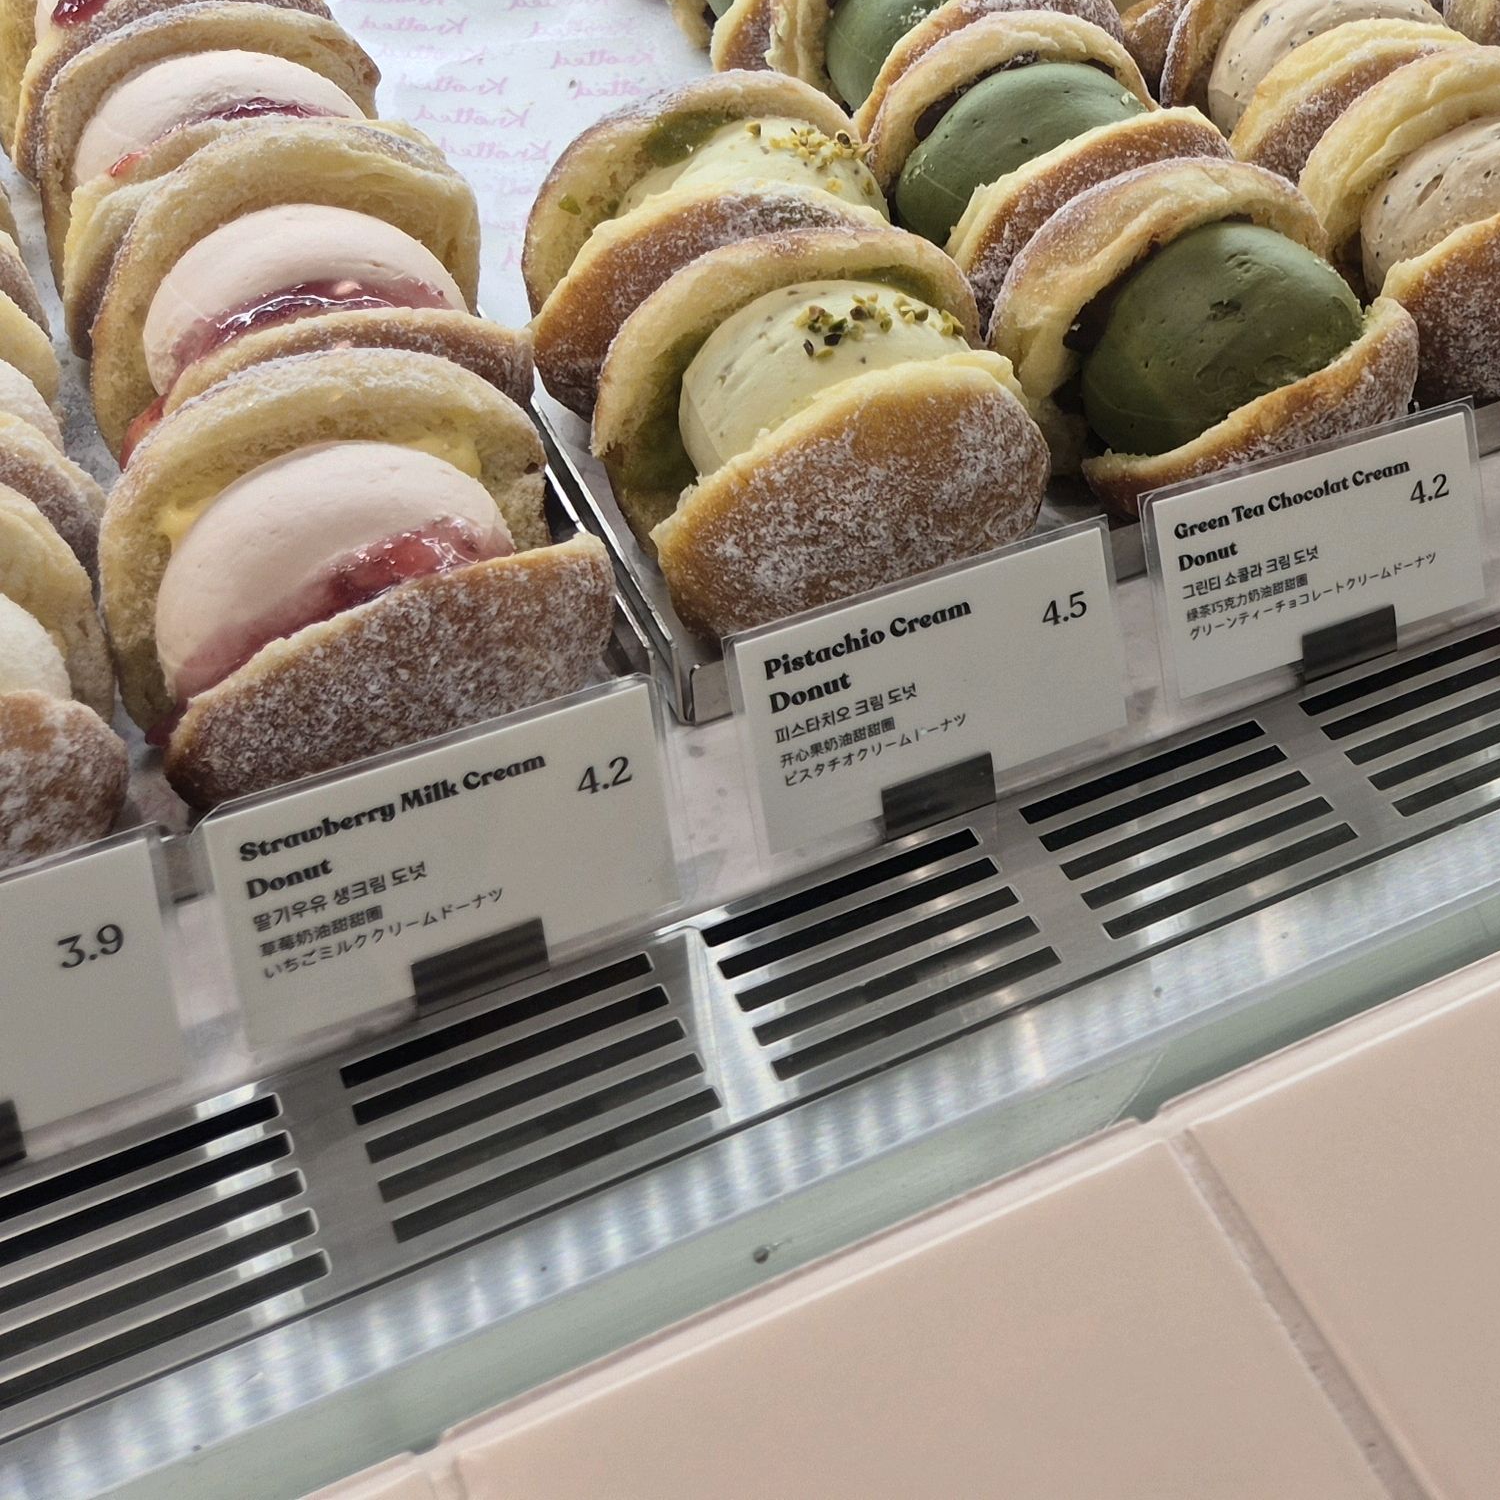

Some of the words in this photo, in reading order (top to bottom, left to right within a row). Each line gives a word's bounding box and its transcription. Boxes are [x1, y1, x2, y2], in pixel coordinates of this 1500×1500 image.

[1173, 514, 1231, 540] Green
[1231, 503, 1266, 523] Tea
[1267, 476, 1350, 512] Chocolat
[1351, 461, 1411, 487] Cream
[1409, 473, 1450, 505] 4.2
[1177, 541, 1239, 572] Donut
[1182, 574, 1222, 600] 그린티
[1224, 561, 1263, 587] 쇼콜라
[1265, 553, 1291, 574] 크림
[1293, 544, 1320, 566] 도넛
[1041, 590, 1088, 626] 4.5
[1189, 551, 1437, 641] グリーンティーチョコレートクリームドーナツ
[763, 627, 886, 681] Pistachio
[889, 601, 972, 638] Cream
[768, 672, 852, 715] Donut
[774, 706, 852, 744] 피스타치오
[854, 693, 885, 717] 크림
[887, 682, 918, 706] 도넛
[779, 715, 896, 769] 开心果奶油甜甜圈
[576, 755, 633, 795] 4.2
[238, 802, 396, 862] Strawberry
[399, 779, 460, 813] Milk
[461, 755, 547, 791] Cream
[245, 858, 334, 900] Donut
[252, 894, 329, 933] 딸기우유
[332, 873, 387, 906] 생크림
[390, 860, 428, 887] 도넛
[57, 923, 125, 970] 3.9
[263, 887, 503, 980] いちごミルククリームドーナツ
